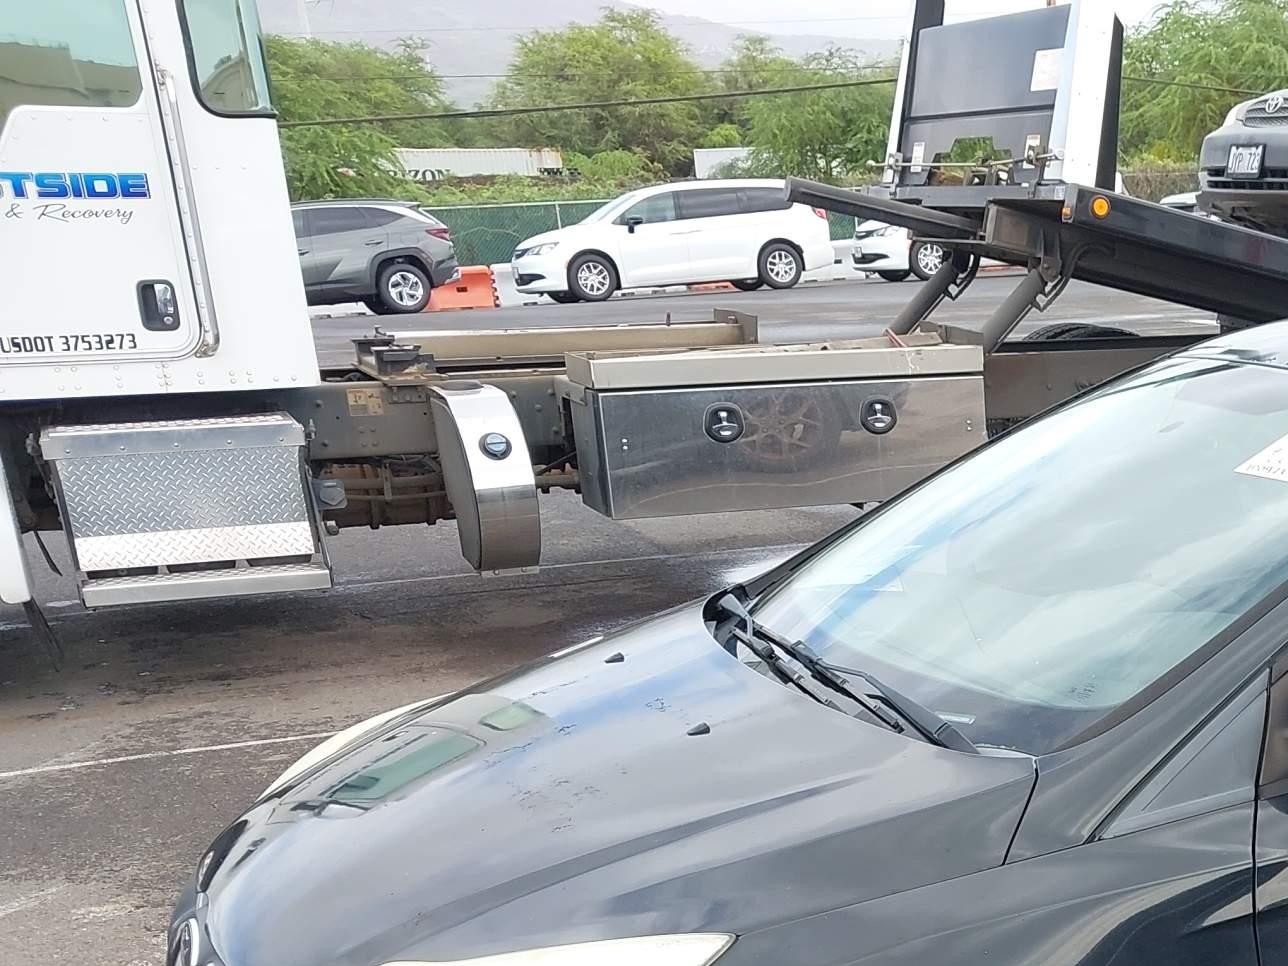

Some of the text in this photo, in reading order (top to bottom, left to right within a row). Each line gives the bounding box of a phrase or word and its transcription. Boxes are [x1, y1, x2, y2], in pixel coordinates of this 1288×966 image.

[0, 171, 151, 200] TSIDE
[5, 203, 134, 225] & Recovery
[0, 333, 137, 353] USDOT 3753273
